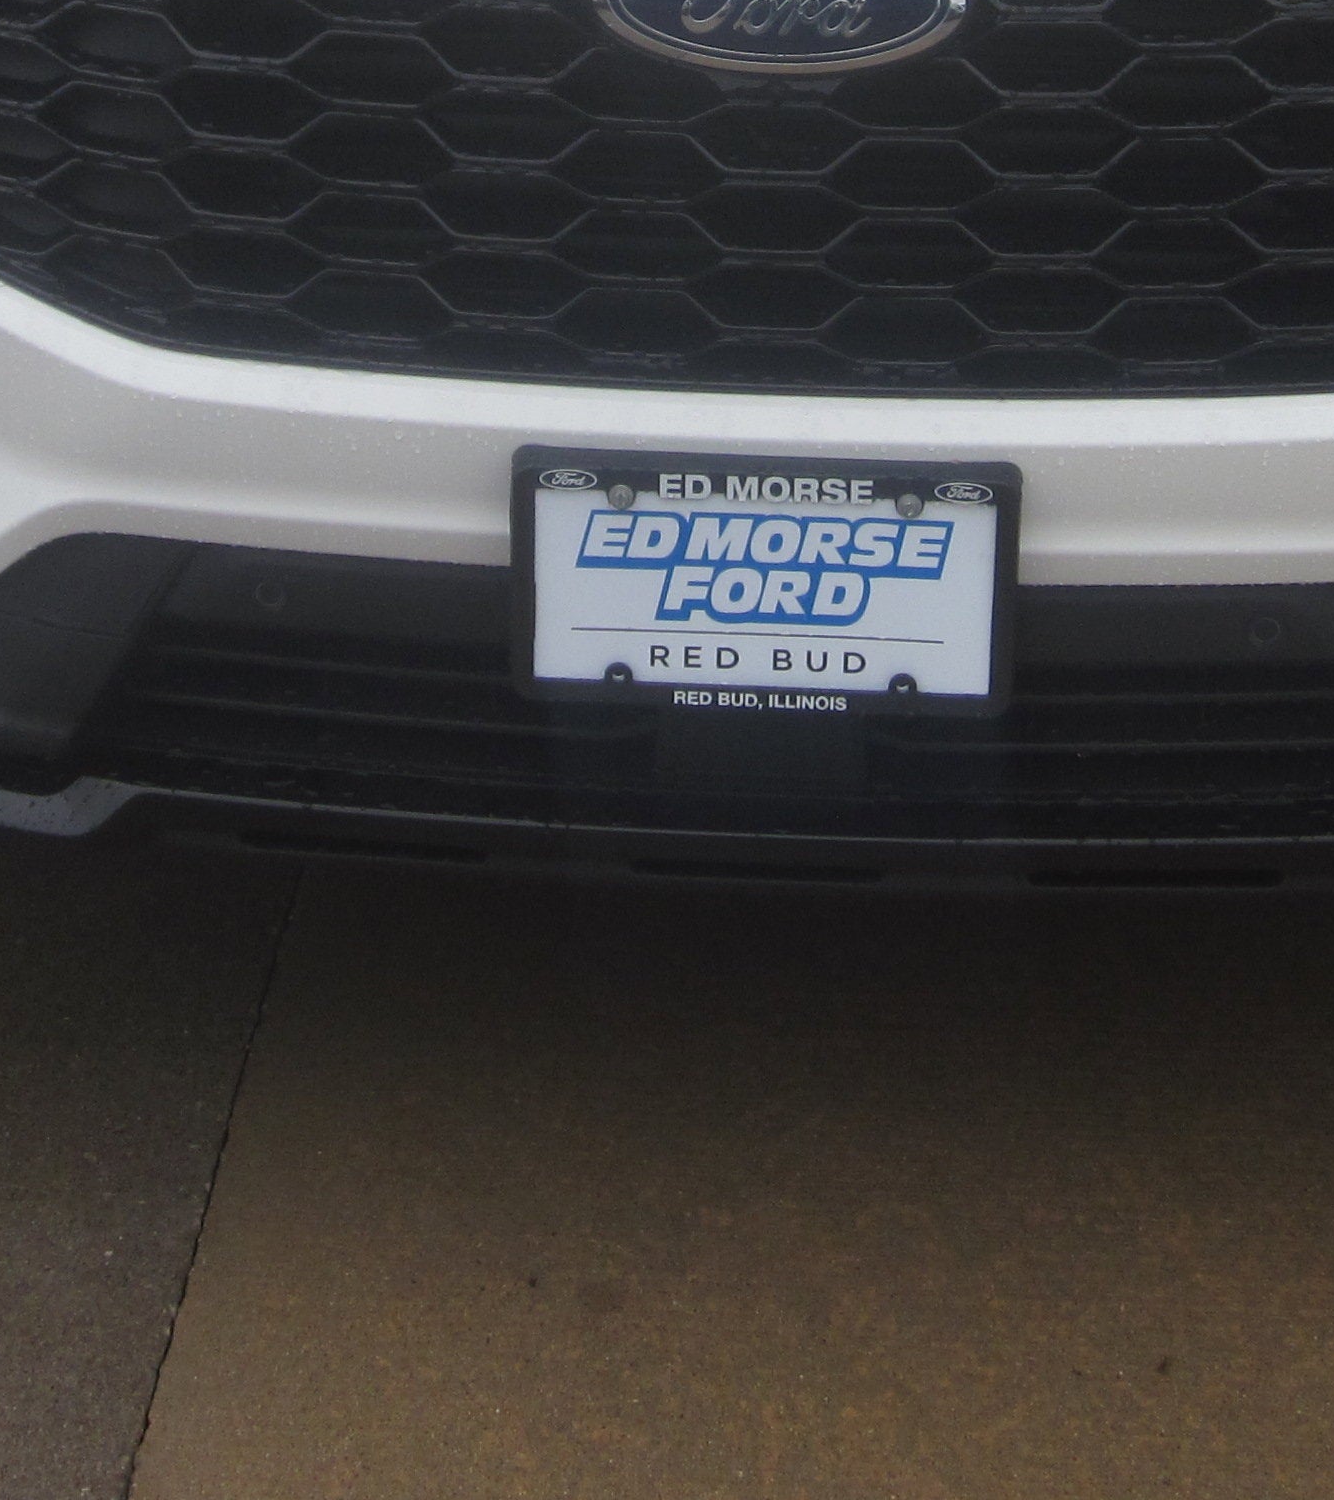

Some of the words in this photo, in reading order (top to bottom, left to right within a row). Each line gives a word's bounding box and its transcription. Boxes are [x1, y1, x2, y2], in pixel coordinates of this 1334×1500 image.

[551, 472, 586, 487] Ford
[658, 473, 712, 501] ED
[725, 475, 874, 505] MORSE
[945, 485, 981, 501] Ford
[581, 513, 680, 560] ED
[683, 516, 948, 569] MORSE
[662, 566, 866, 618] FORD
[649, 644, 740, 670] RED
[772, 648, 867, 675] BUD
[673, 690, 713, 706] RED
[717, 692, 764, 710] BUD,
[768, 694, 848, 712] ILLINOIS
